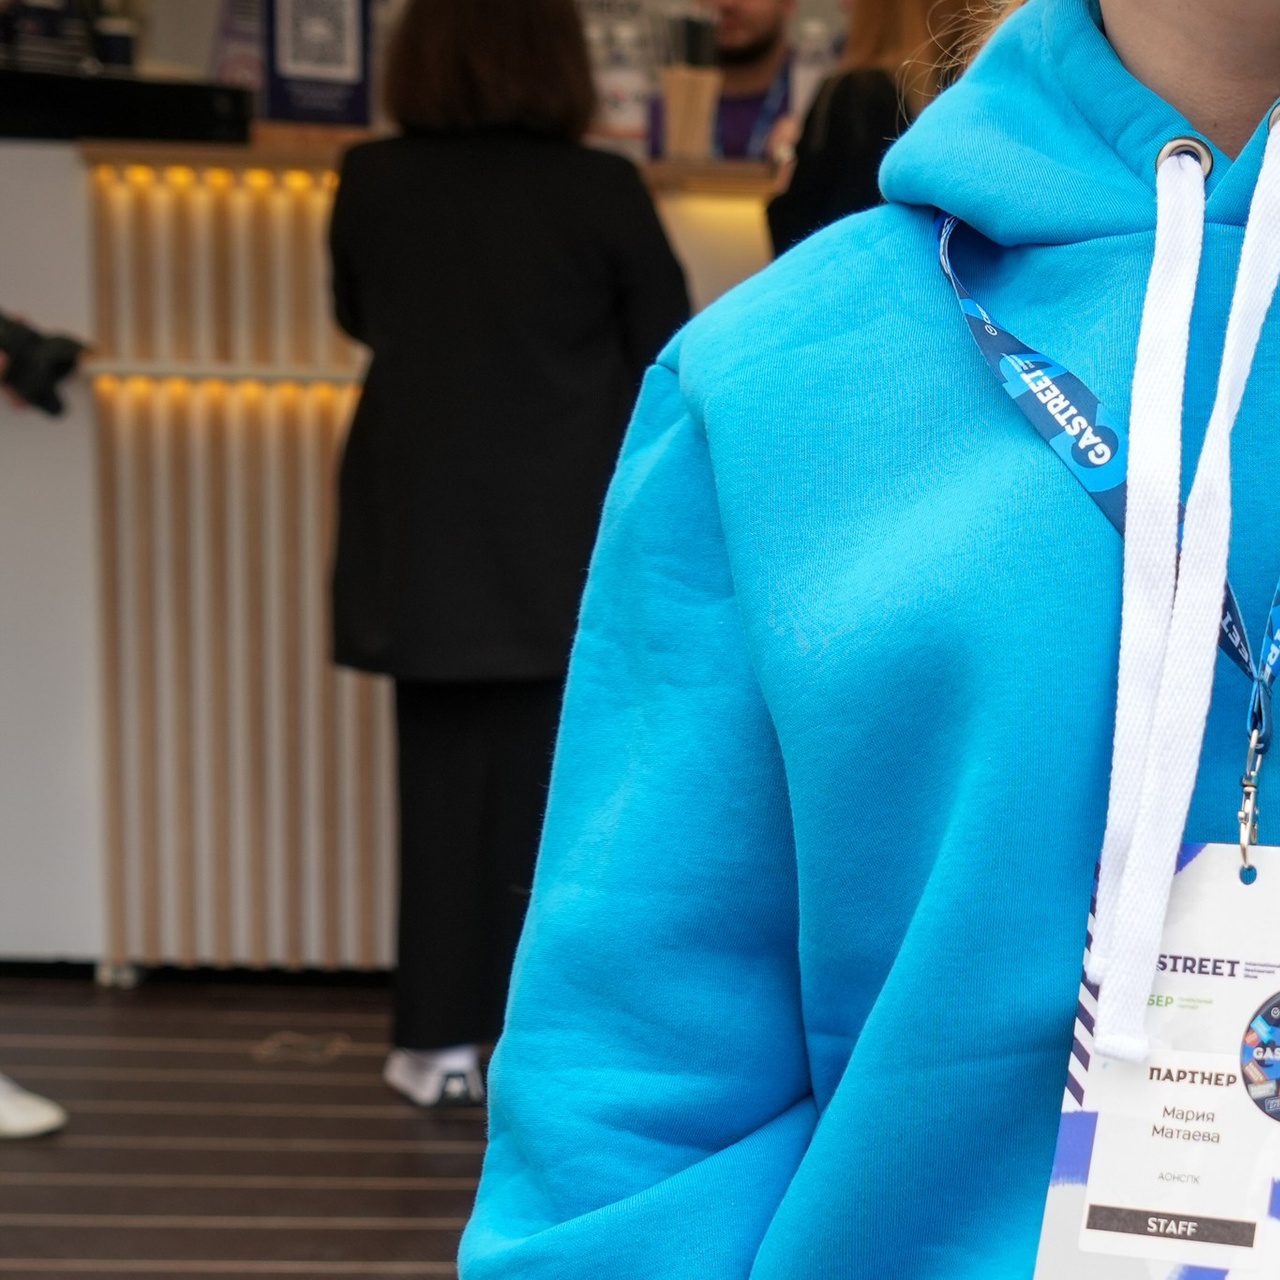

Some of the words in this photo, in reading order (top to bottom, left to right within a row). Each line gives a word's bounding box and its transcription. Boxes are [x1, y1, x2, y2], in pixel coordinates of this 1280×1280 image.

[1019, 368, 1113, 466] GASTREET
[1156, 953, 1240, 978] STREET
[1147, 994, 1174, 1007] БЕР
[1148, 1066, 1238, 1087] ПАРТНЕР
[1162, 1104, 1216, 1123] Мария
[1151, 1124, 1221, 1144] Матаева
[1146, 1216, 1199, 1237] STAFF
